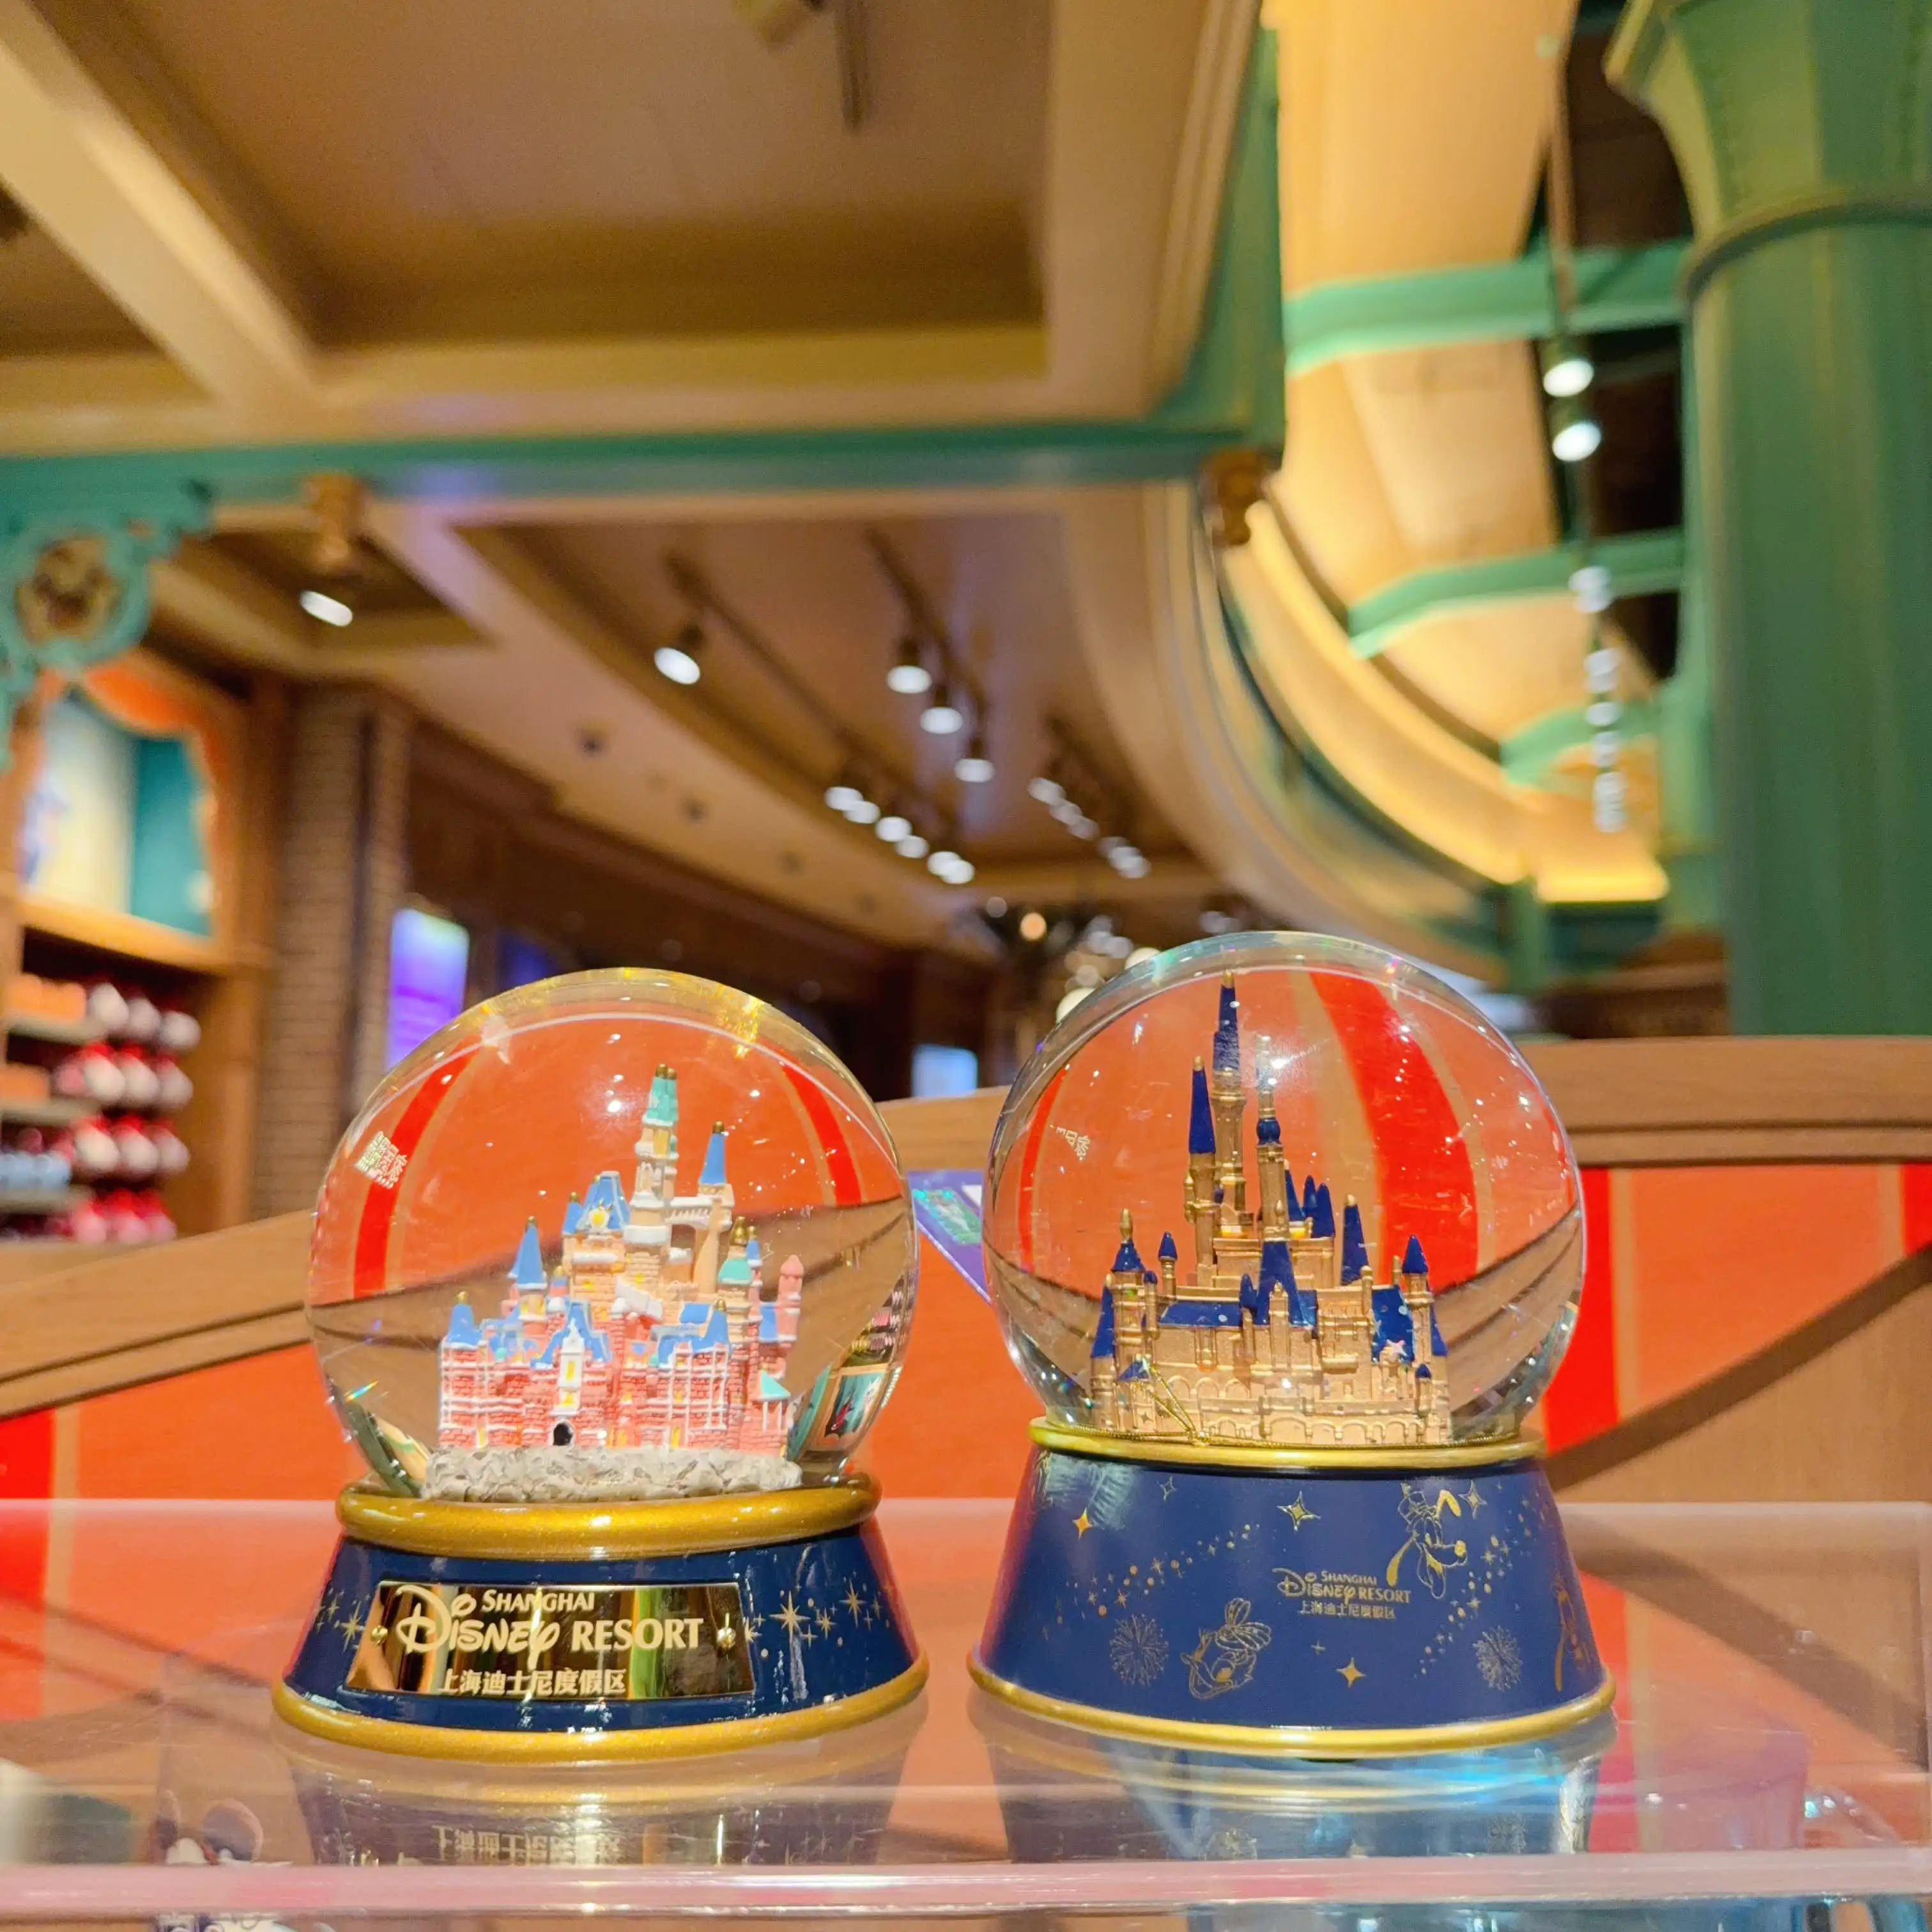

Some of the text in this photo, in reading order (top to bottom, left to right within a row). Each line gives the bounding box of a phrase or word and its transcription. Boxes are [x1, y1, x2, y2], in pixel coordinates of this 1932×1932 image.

[1321, 1570, 1377, 1585] SHANGHAI
[480, 1589, 595, 1613] SHANGHAI
[1358, 1588, 1411, 1604] RESORT
[1299, 1600, 1396, 1620] 上海迪士尼度假区
[571, 1618, 704, 1652] RESORT
[437, 1667, 627, 1697] 上海迪士尼度假区
